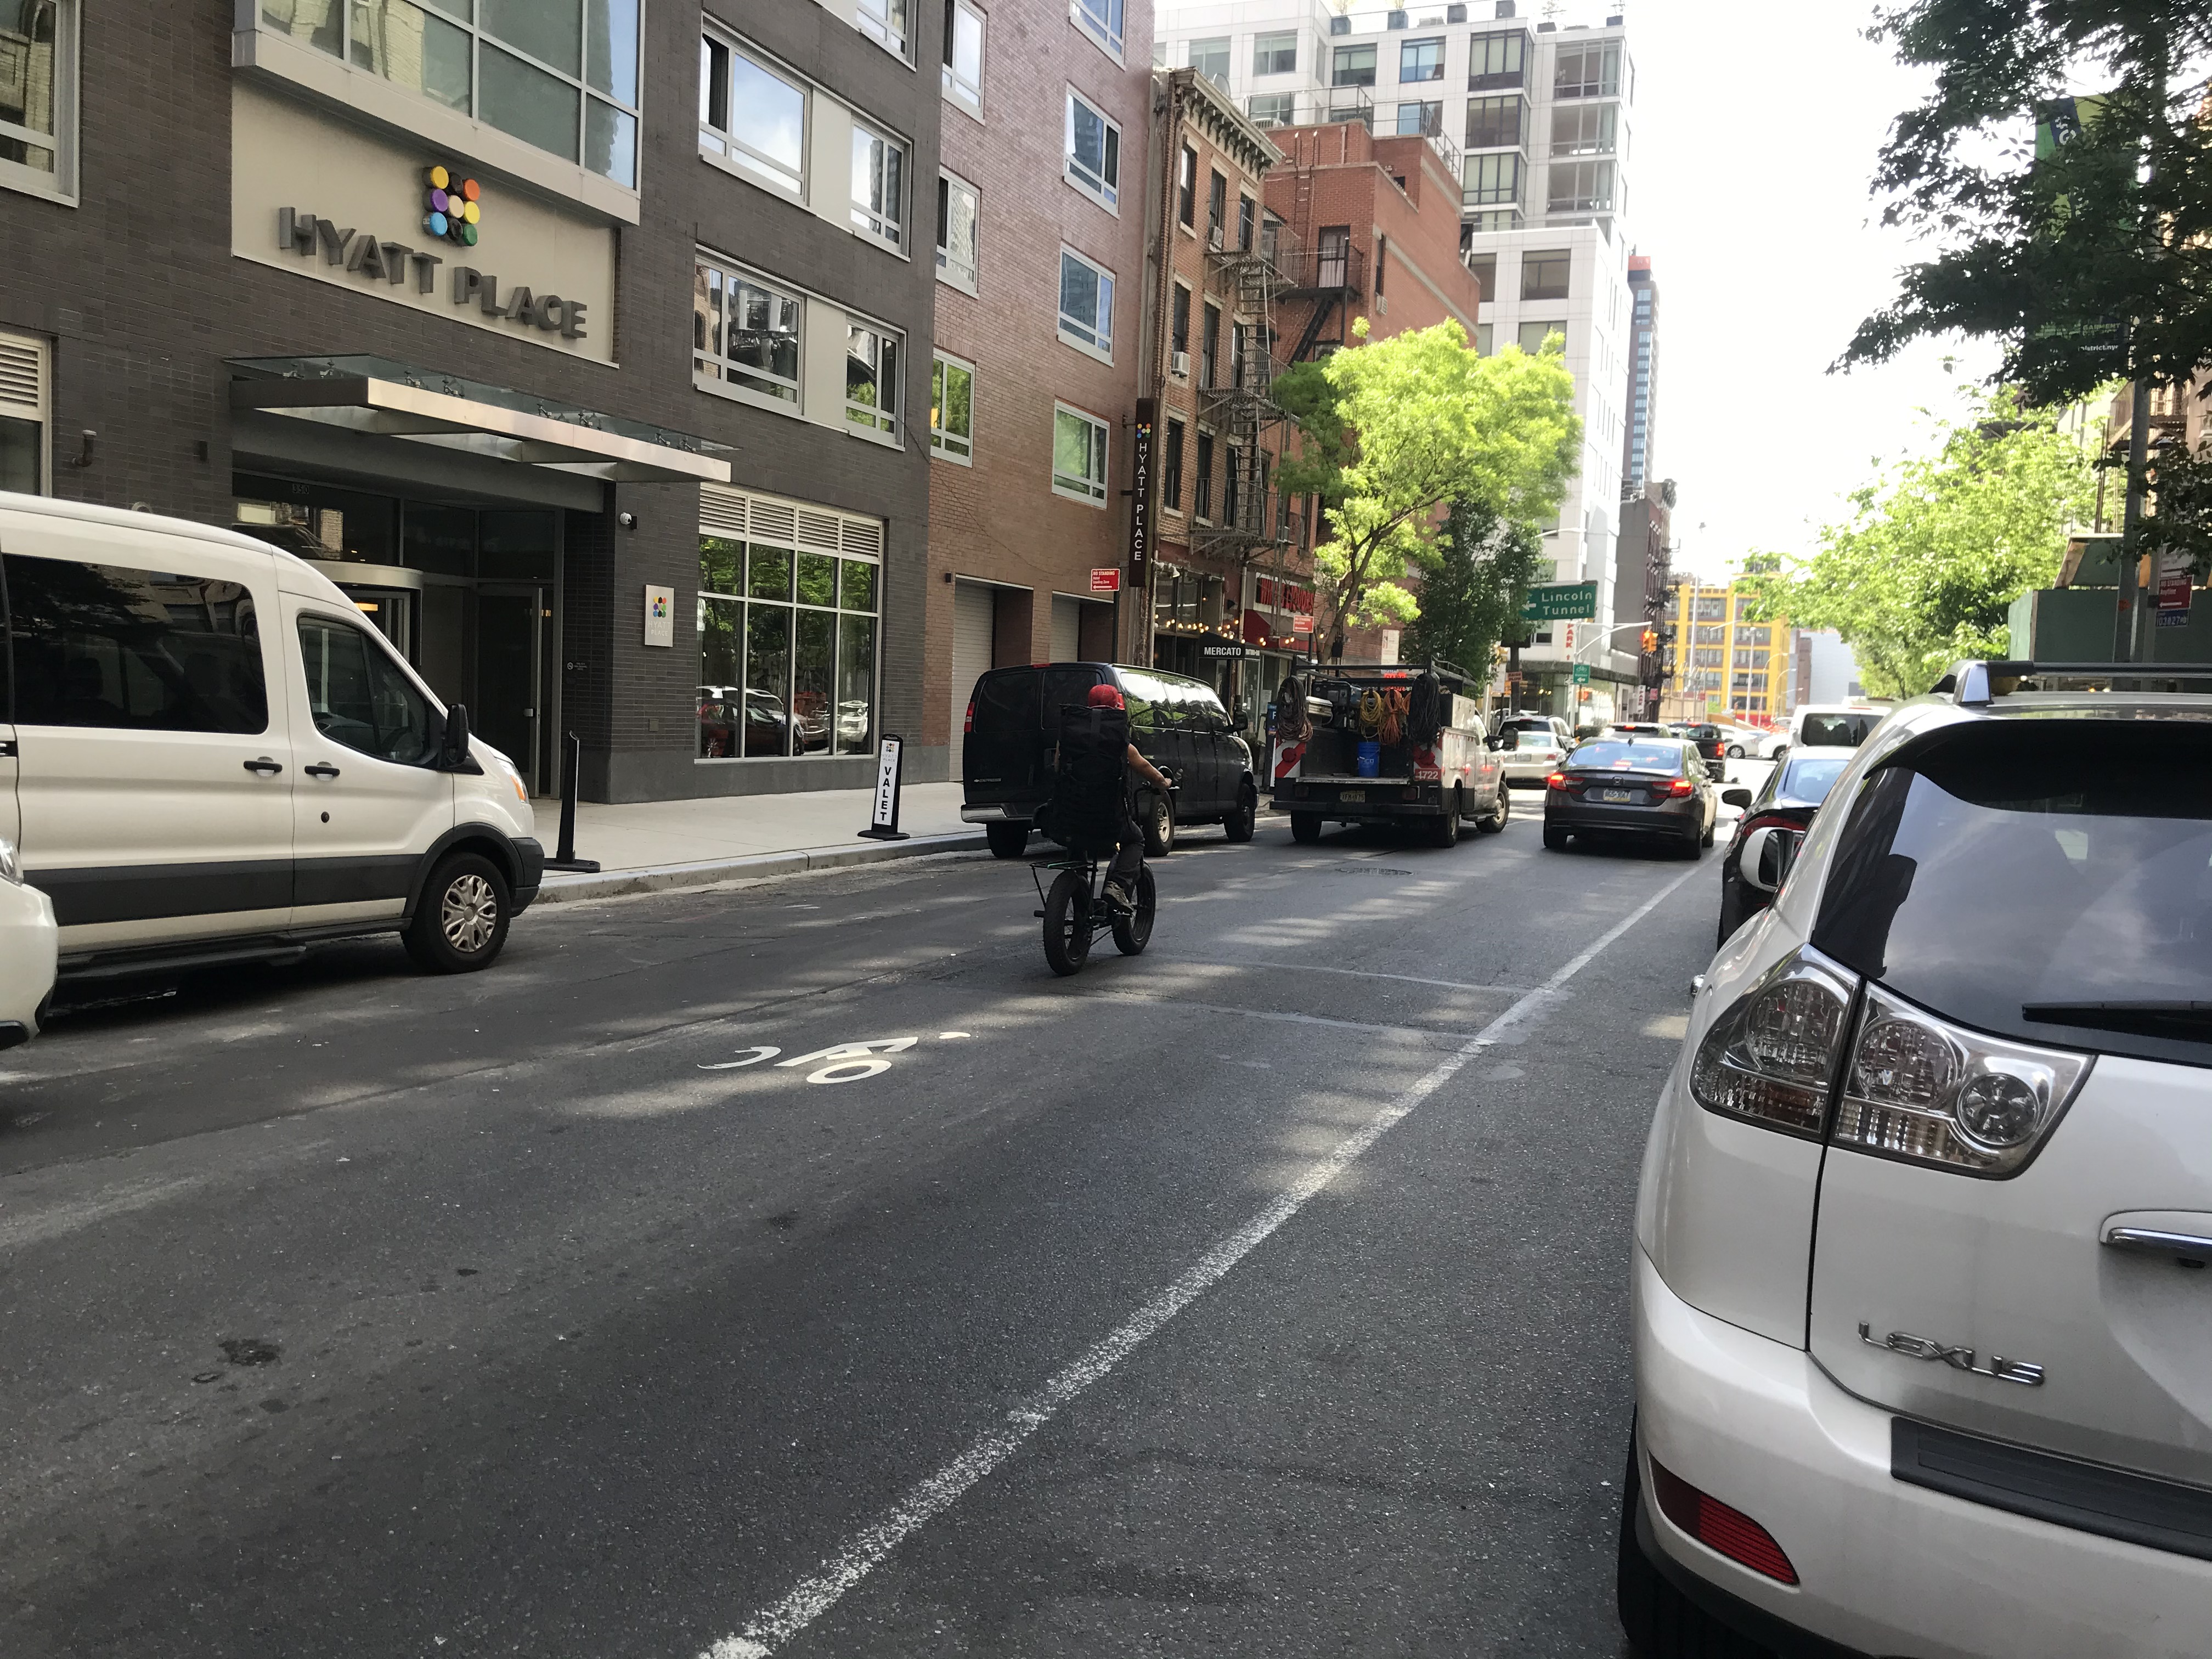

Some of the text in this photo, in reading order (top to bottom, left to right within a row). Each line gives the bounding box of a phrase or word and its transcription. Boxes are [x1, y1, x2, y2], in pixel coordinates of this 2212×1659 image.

[280, 207, 587, 338] HYATT PLACE
[1135, 443, 1147, 561] HYATT PLACE
[1542, 590, 1592, 602] Lincoln
[1543, 604, 1589, 615] Tunnel
[648, 620, 671, 629] HYATT
[1566, 624, 1574, 648] PARK
[1204, 647, 1242, 656] MERCATO
[880, 766, 892, 821] VALET
[1858, 1321, 2045, 1386] LEXUS
